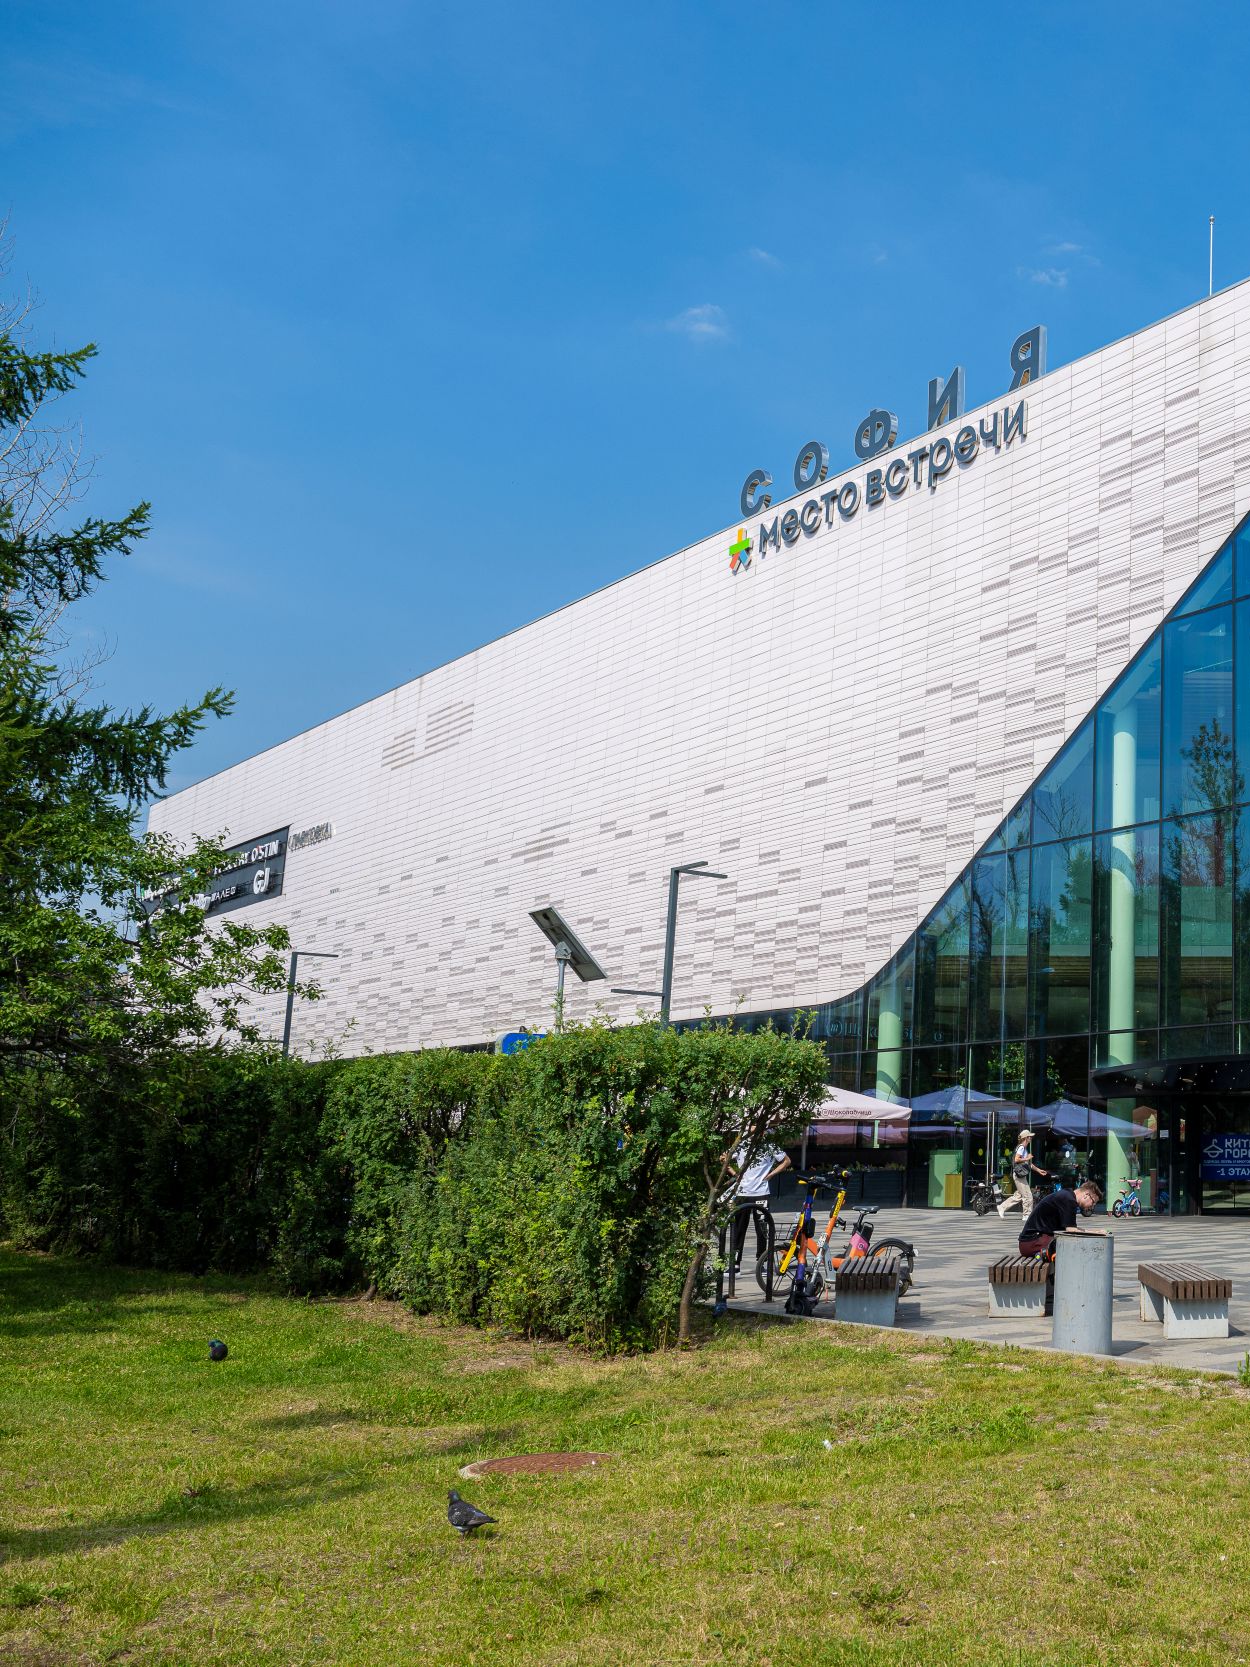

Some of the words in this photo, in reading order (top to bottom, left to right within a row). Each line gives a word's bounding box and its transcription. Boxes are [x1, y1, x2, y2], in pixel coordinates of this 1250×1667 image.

[740, 324, 1048, 519] СОФИЯ
[865, 400, 1029, 506] встречи
[1216, 1167, 1226, 1176] -1
